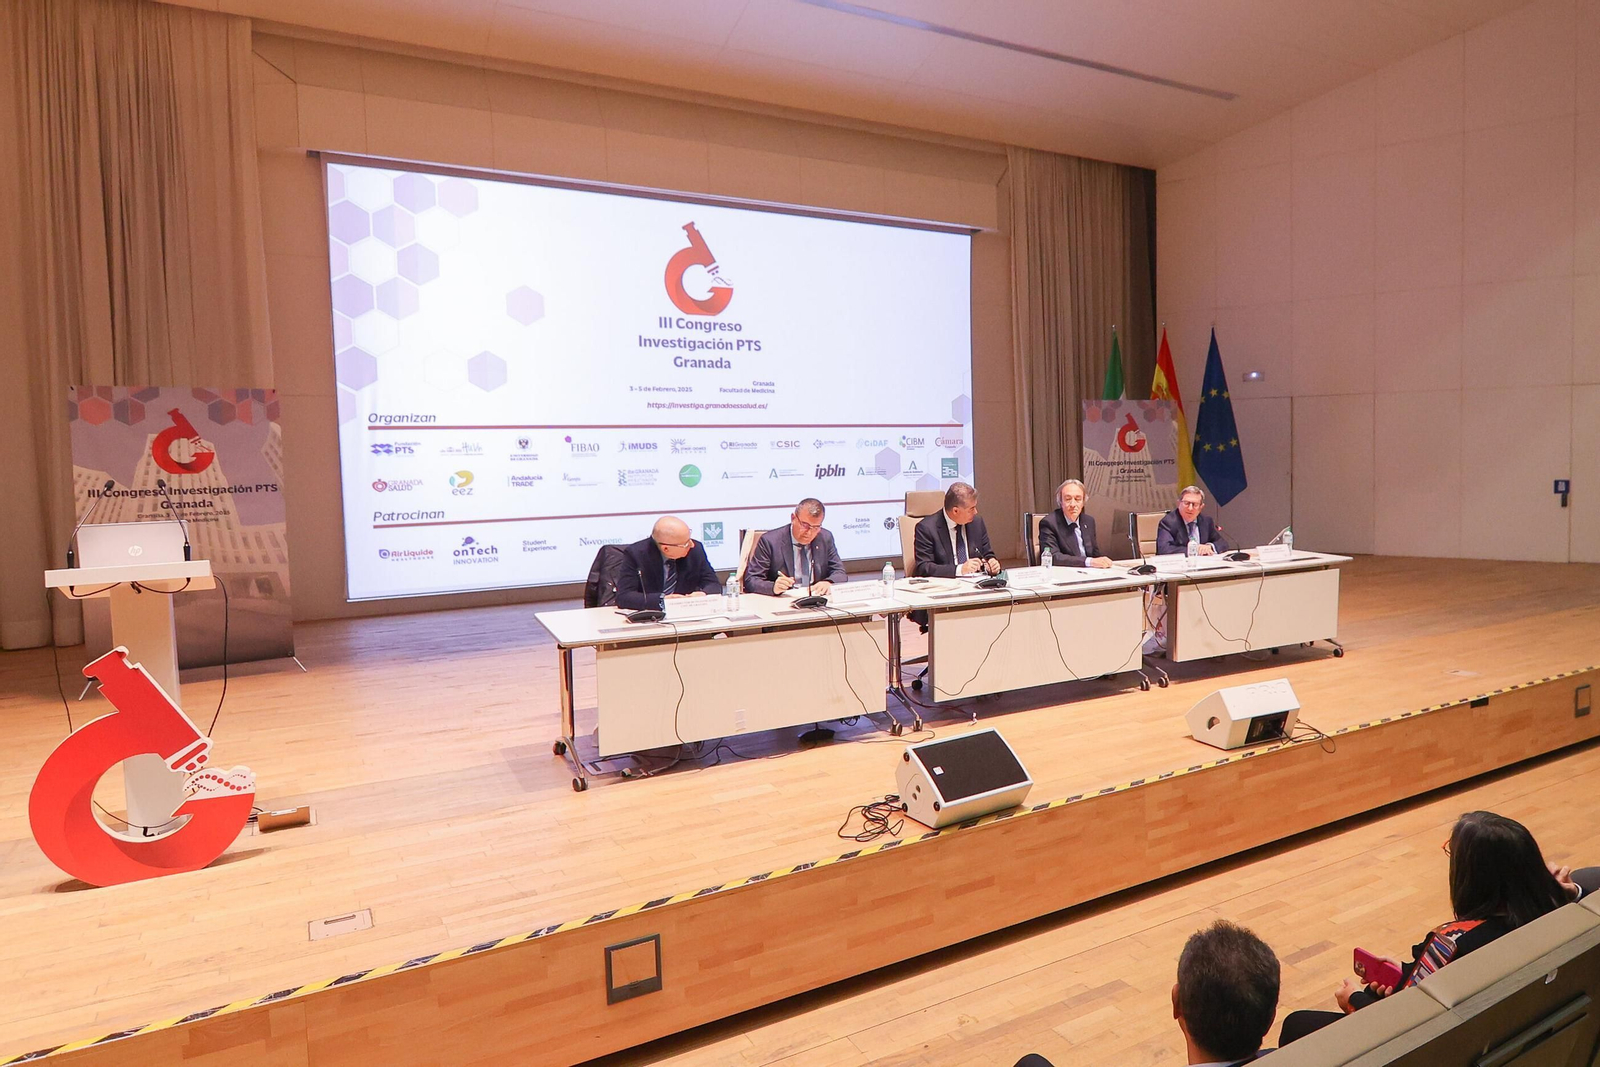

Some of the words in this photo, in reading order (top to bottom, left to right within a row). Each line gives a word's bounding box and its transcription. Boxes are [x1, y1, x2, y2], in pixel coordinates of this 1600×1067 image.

[659, 316, 673, 329] III
[676, 317, 742, 333] Congreso
[638, 335, 733, 351] Investigación
[736, 339, 762, 352] PTS
[673, 356, 732, 369] Granada
[368, 413, 437, 425] Organizan
[570, 443, 600, 452] FIBAO
[776, 440, 800, 448] CSIC
[906, 438, 925, 446] CIBM
[395, 446, 415, 454] PTS
[815, 464, 846, 480] ipbln
[104, 487, 165, 499] Congreso
[170, 484, 253, 498] Investigación
[256, 483, 278, 493] PTS
[388, 484, 413, 492] SALUD
[452, 487, 474, 496] eez
[160, 499, 214, 510] Granada
[373, 510, 445, 522] Patrocinan
[129, 545, 142, 557] hp
[453, 545, 498, 557] onTech
[453, 556, 499, 565] INNOVATION
